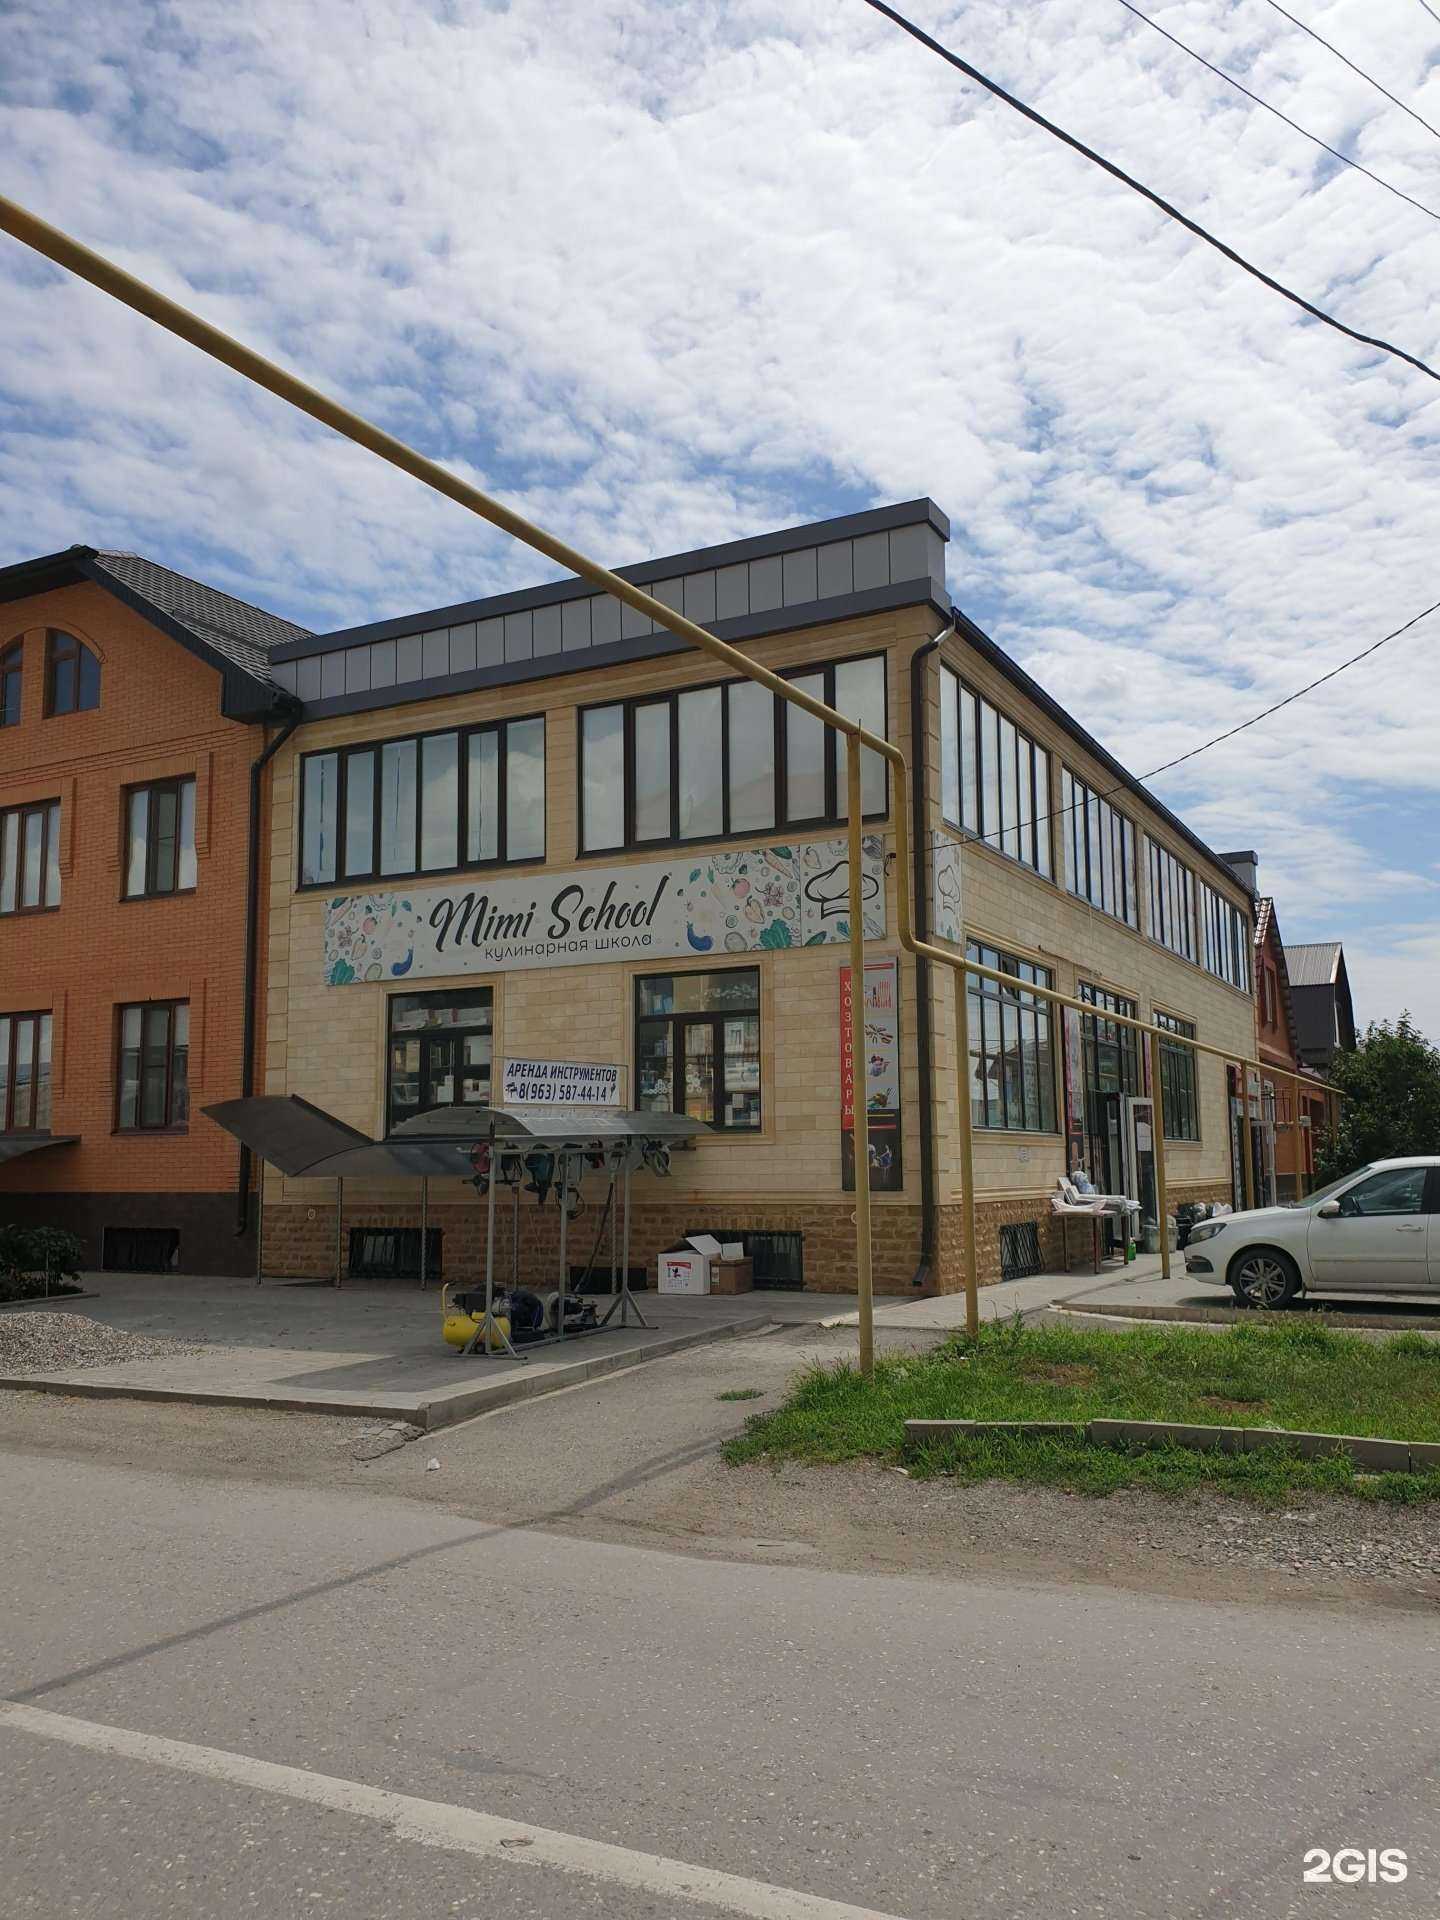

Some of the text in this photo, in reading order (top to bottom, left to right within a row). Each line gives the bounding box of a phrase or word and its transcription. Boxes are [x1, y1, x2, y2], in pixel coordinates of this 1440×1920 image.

[429, 874, 670, 953] Mimi School
[485, 933, 652, 962] кулинарная школа
[844, 981, 854, 1115] ХОЗТОВАРЫ
[507, 1063, 617, 1081] АРЕНДА ИНСТРУМЕНТОВ
[518, 1081, 607, 1101] 8(963) 587-44-14
